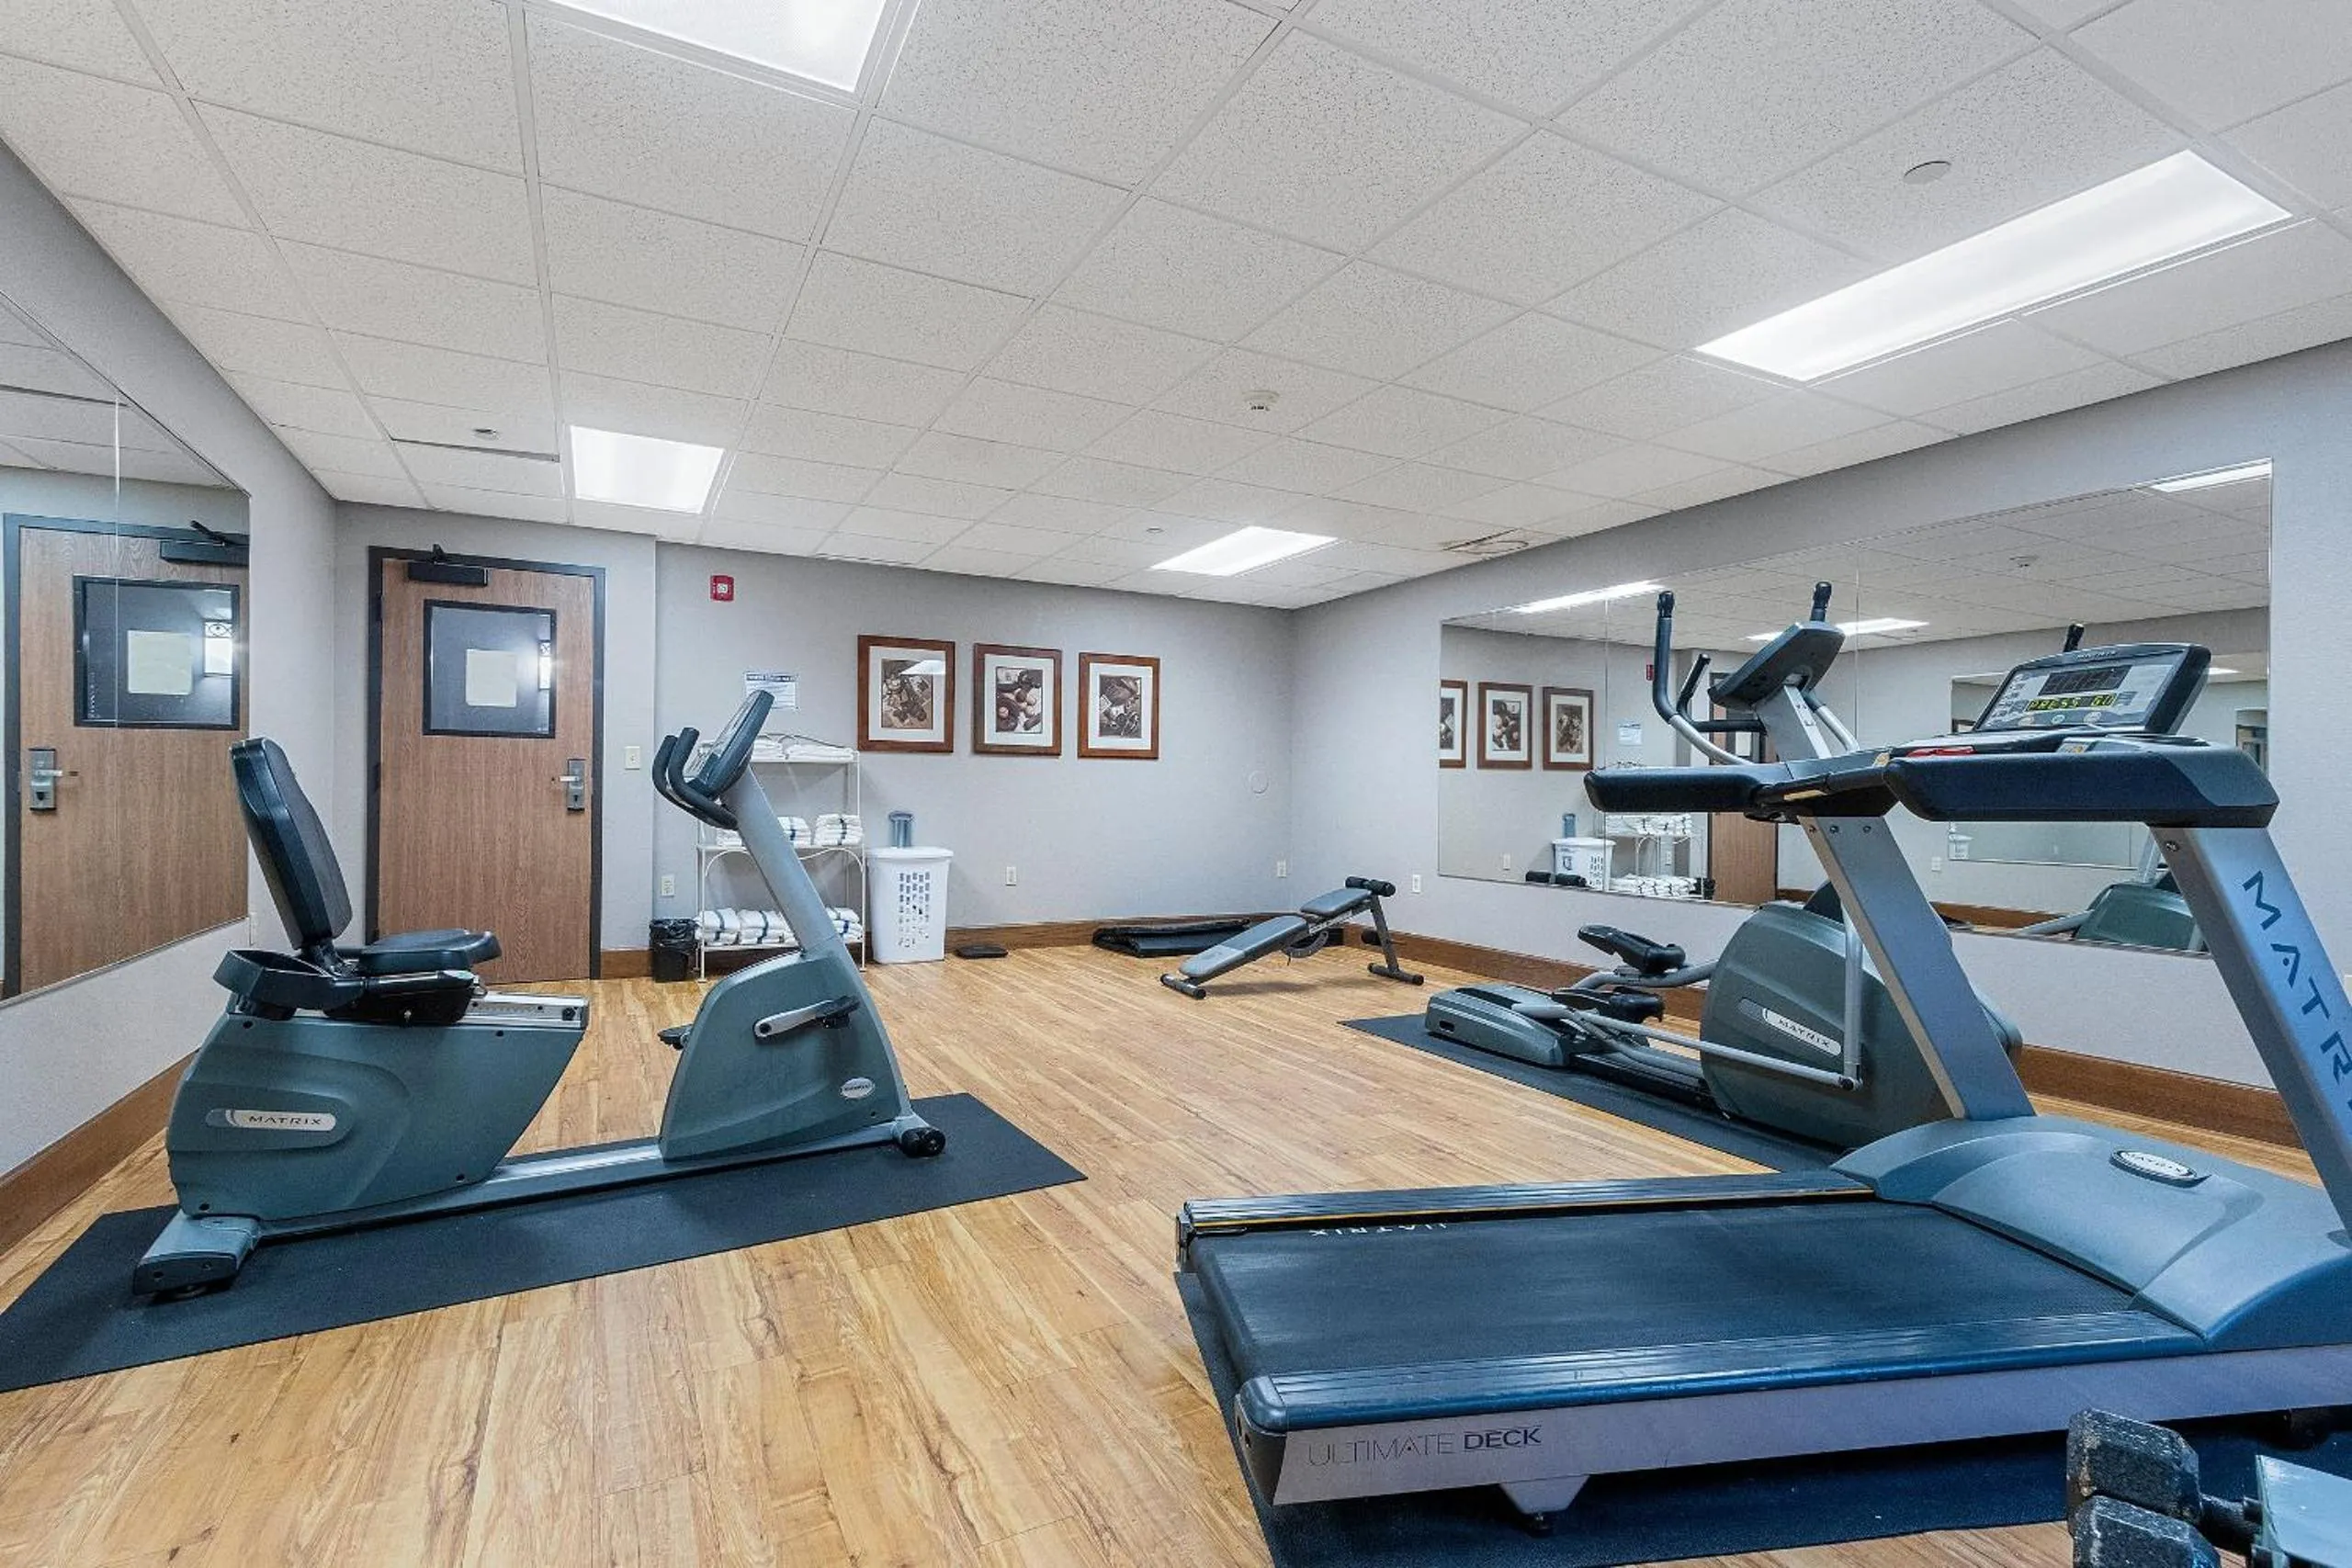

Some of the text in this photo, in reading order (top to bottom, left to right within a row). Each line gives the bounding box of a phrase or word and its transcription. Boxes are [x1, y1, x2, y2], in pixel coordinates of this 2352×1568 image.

[2243, 870, 2352, 1111] MATR
[1779, 1018, 1830, 1048] MATRIX
[249, 1115, 322, 1125] MATRIX
[1308, 1427, 1543, 1467] ULTIMATE DECK
